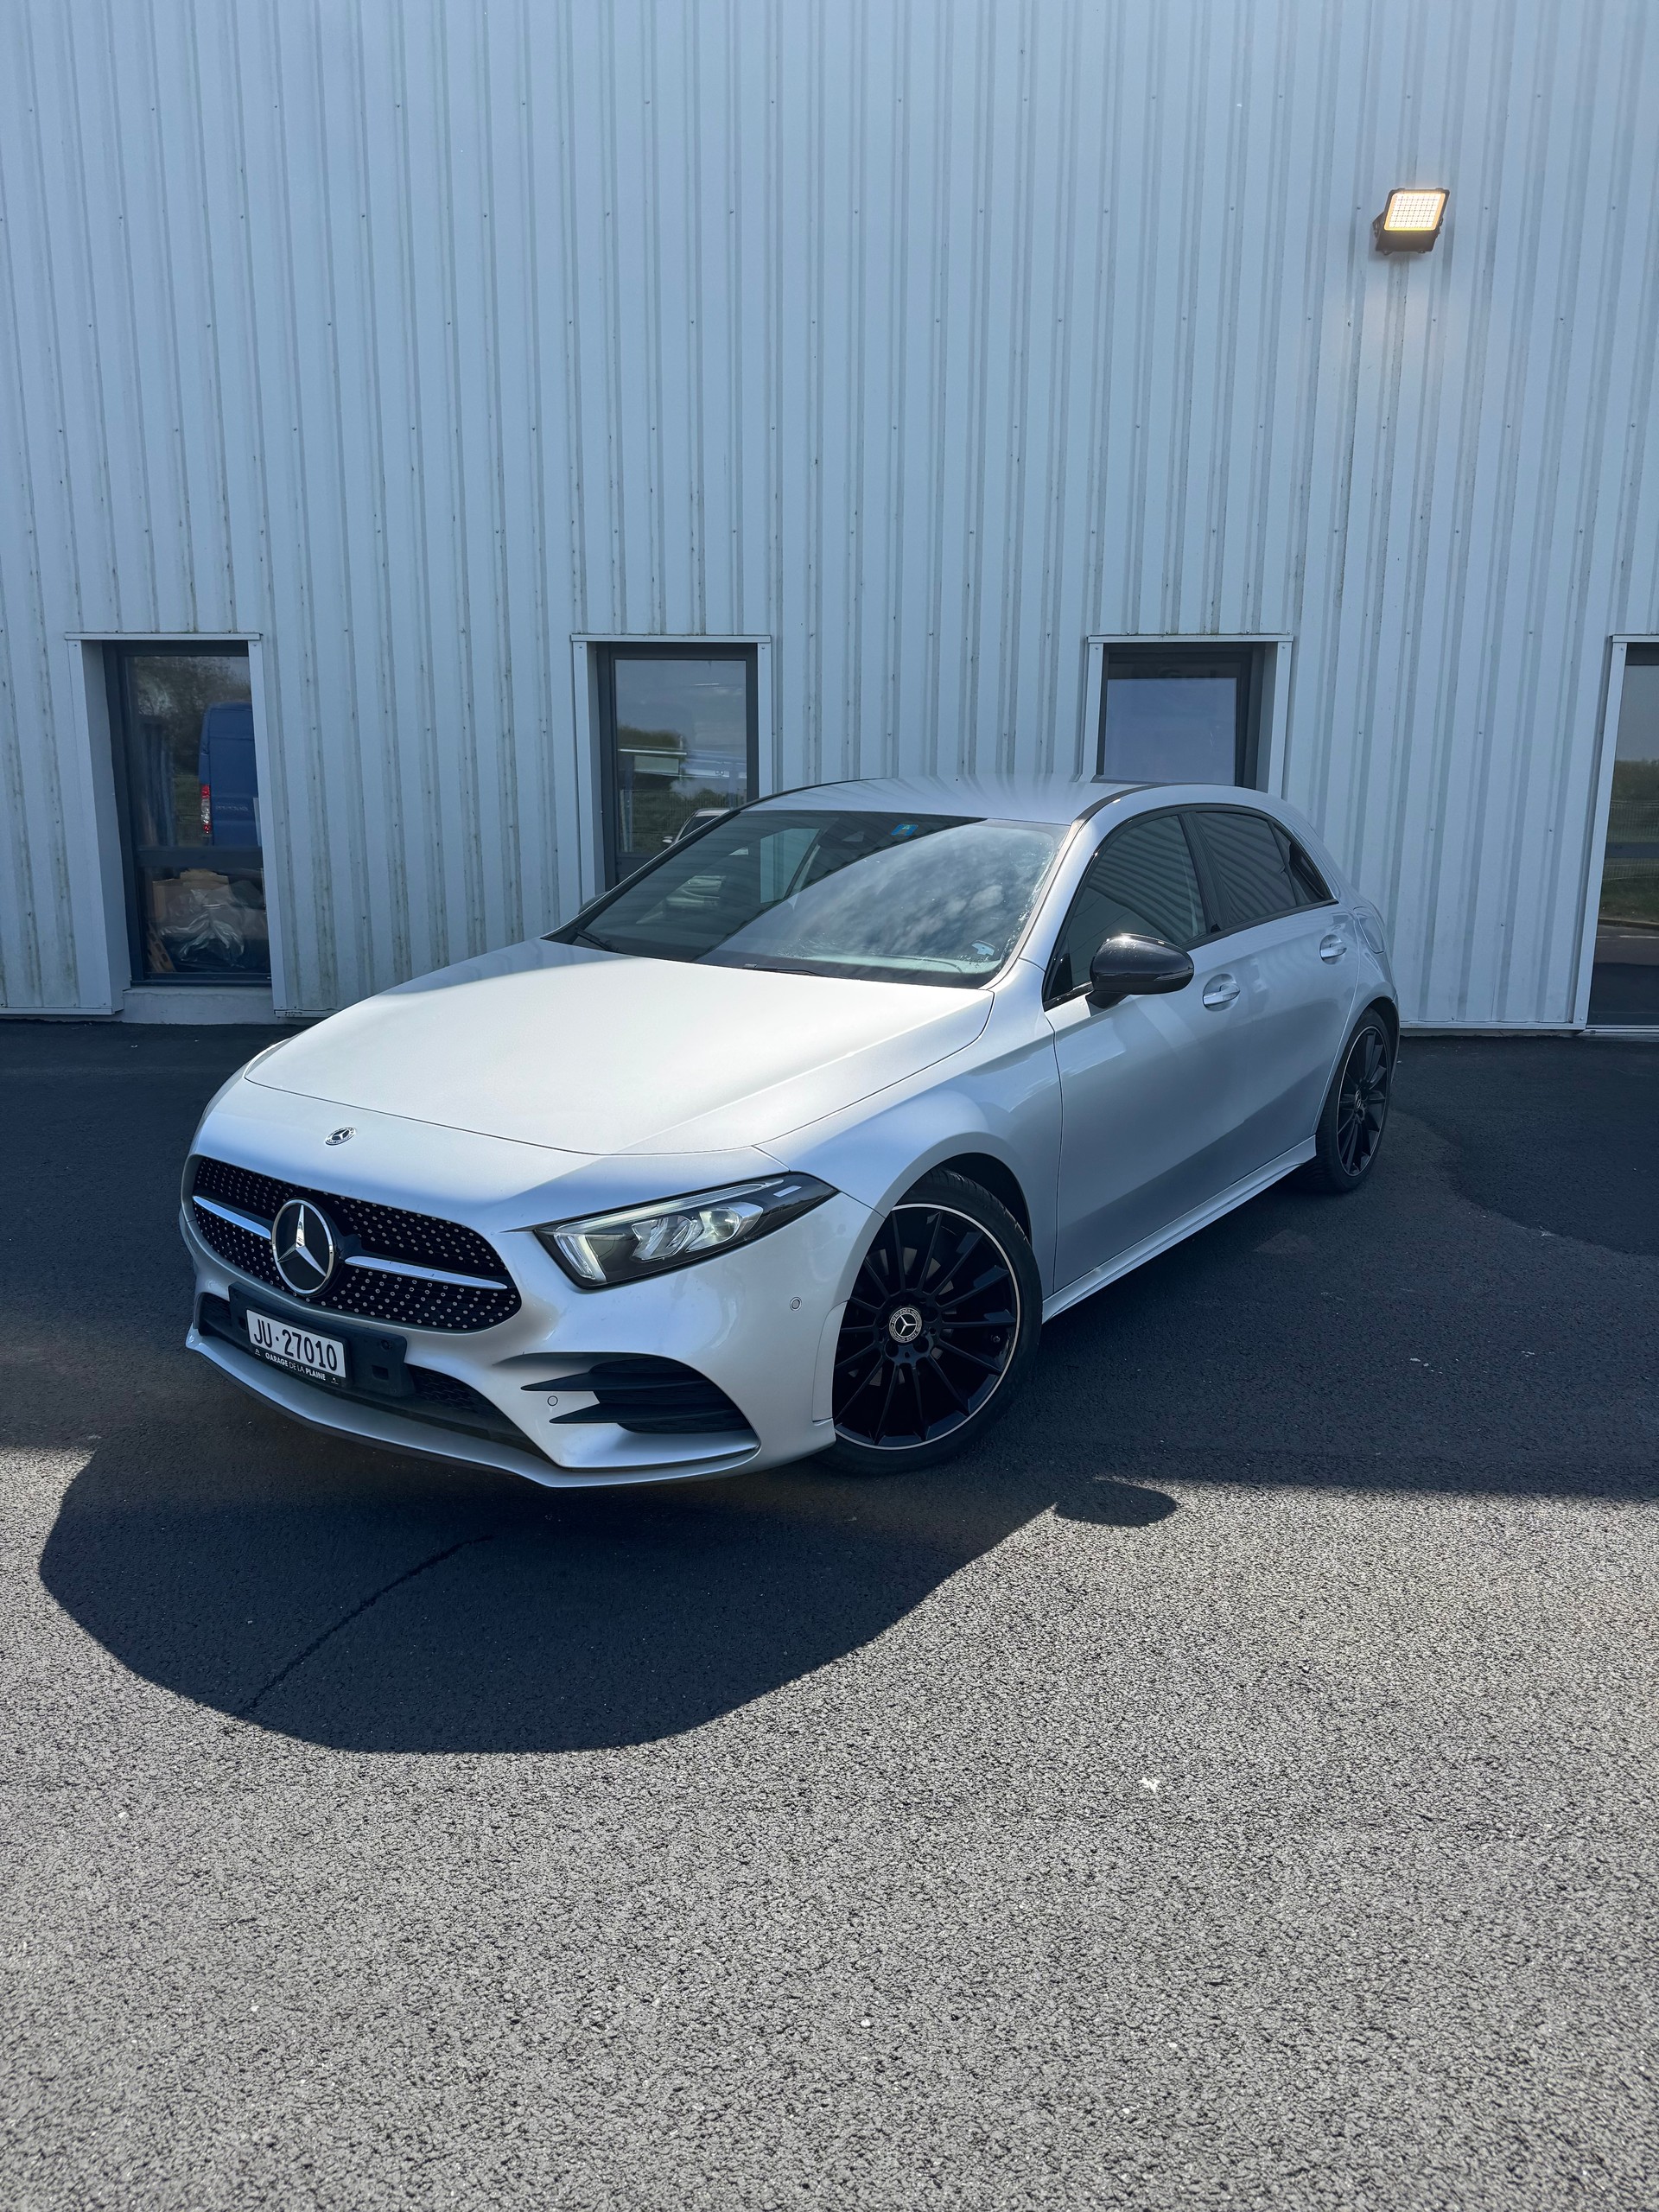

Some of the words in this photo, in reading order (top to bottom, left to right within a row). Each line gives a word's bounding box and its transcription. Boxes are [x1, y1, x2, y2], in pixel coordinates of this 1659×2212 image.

[265, 1352, 289, 1367] GARAGE
[289, 1361, 297, 1370] DE
[305, 1367, 326, 1381] PLAINE
